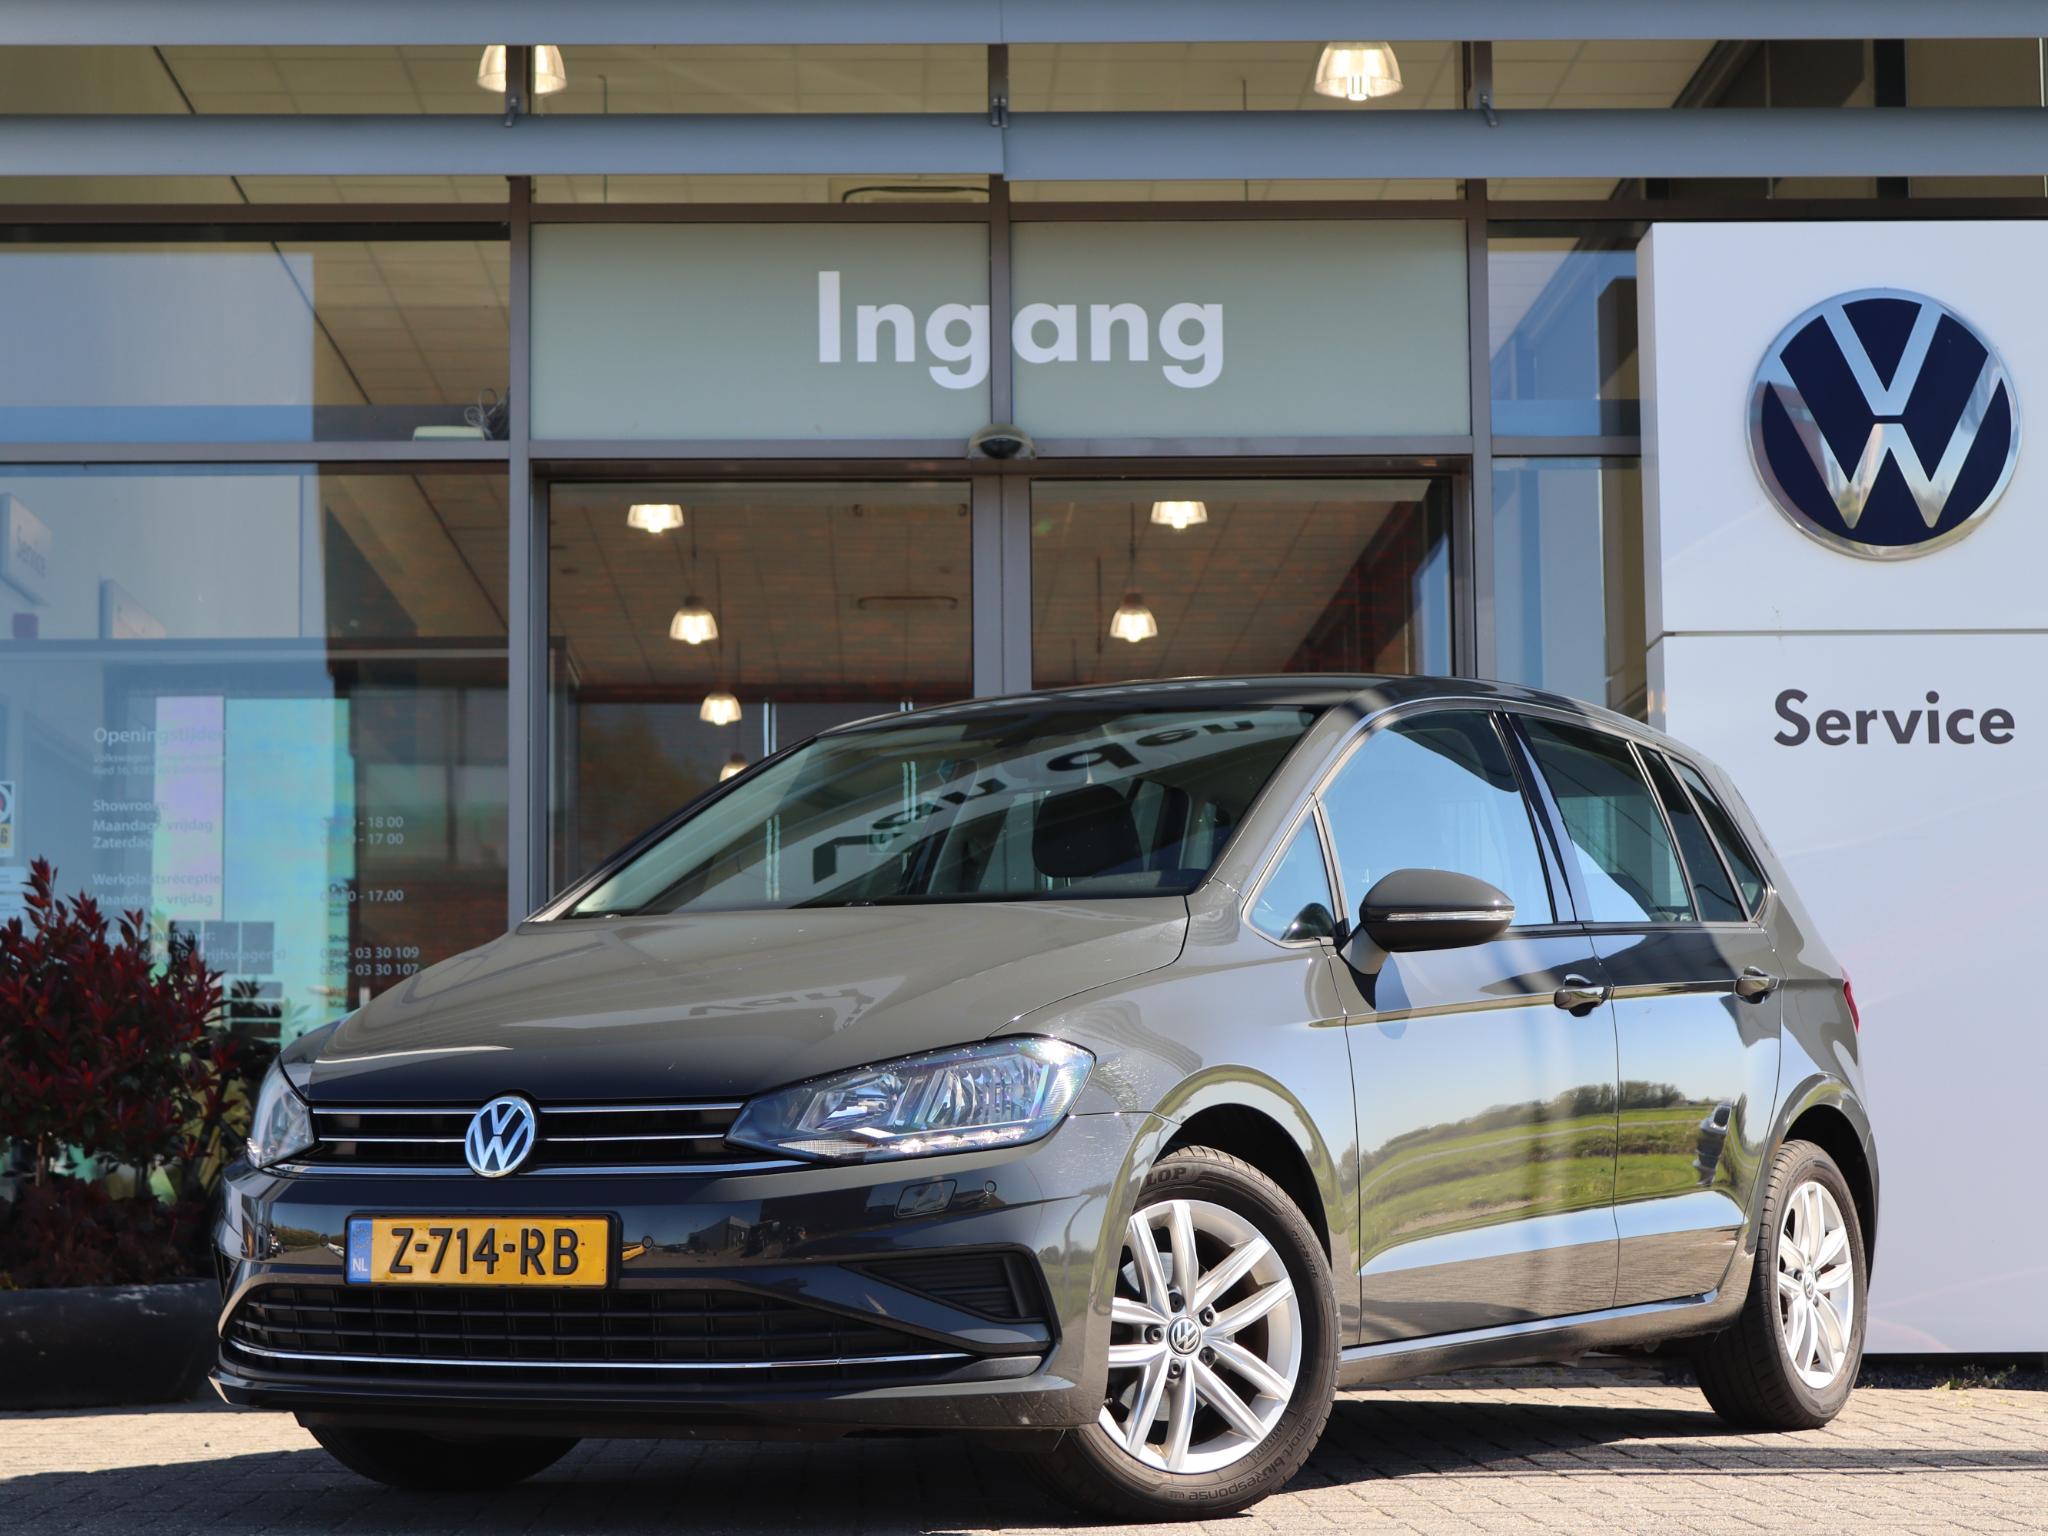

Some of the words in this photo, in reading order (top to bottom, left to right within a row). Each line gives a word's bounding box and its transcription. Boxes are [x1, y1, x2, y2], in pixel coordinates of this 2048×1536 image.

[818, 270, 1224, 390] Ingang
[1756, 293, 2012, 540] VW
[1773, 688, 2016, 747] Service
[368, 890, 405, 903] 17.00
[354, 946, 372, 959] 03
[375, 946, 392, 959] 30
[396, 946, 420, 959] 109
[354, 963, 372, 976] 03
[375, 963, 392, 976] 30
[396, 963, 420, 976] 107
[466, 1096, 536, 1177] VW
[1145, 1167, 1187, 1186] LOP
[352, 1258, 369, 1273] NL
[388, 1226, 581, 1277] Z-714-RB
